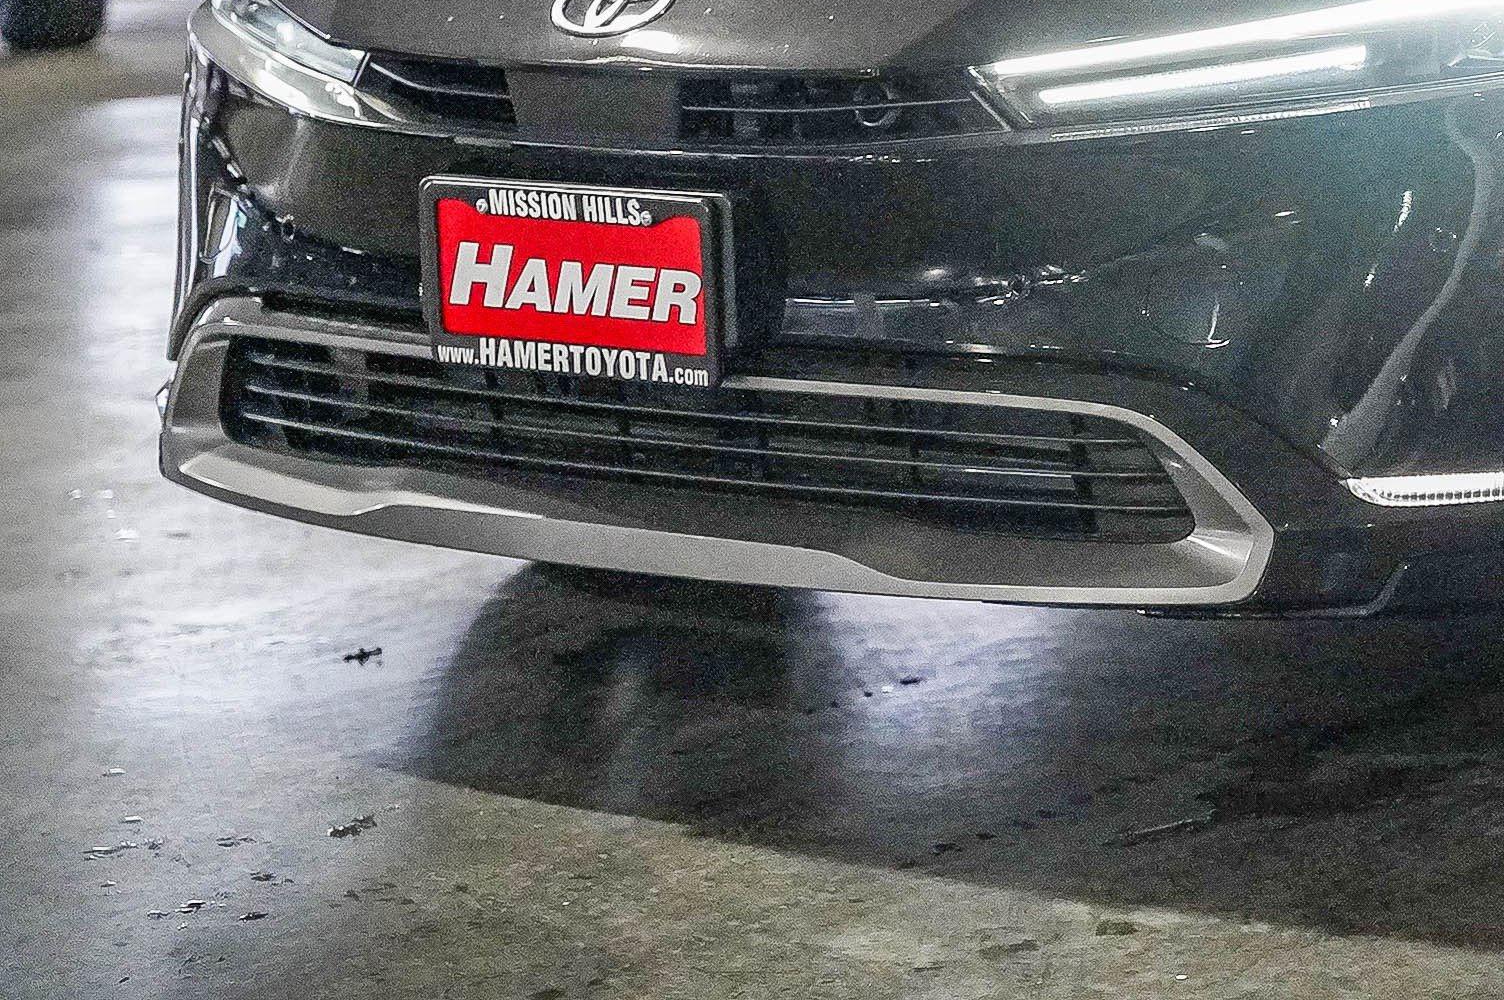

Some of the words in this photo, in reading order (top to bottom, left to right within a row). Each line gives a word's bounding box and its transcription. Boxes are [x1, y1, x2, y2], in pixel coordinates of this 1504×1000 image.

[488, 188, 576, 221] MISSION
[582, 195, 641, 226] HILLS
[449, 241, 702, 325] HAMER
[437, 338, 709, 387] www.HAMERTOYOTA.com
